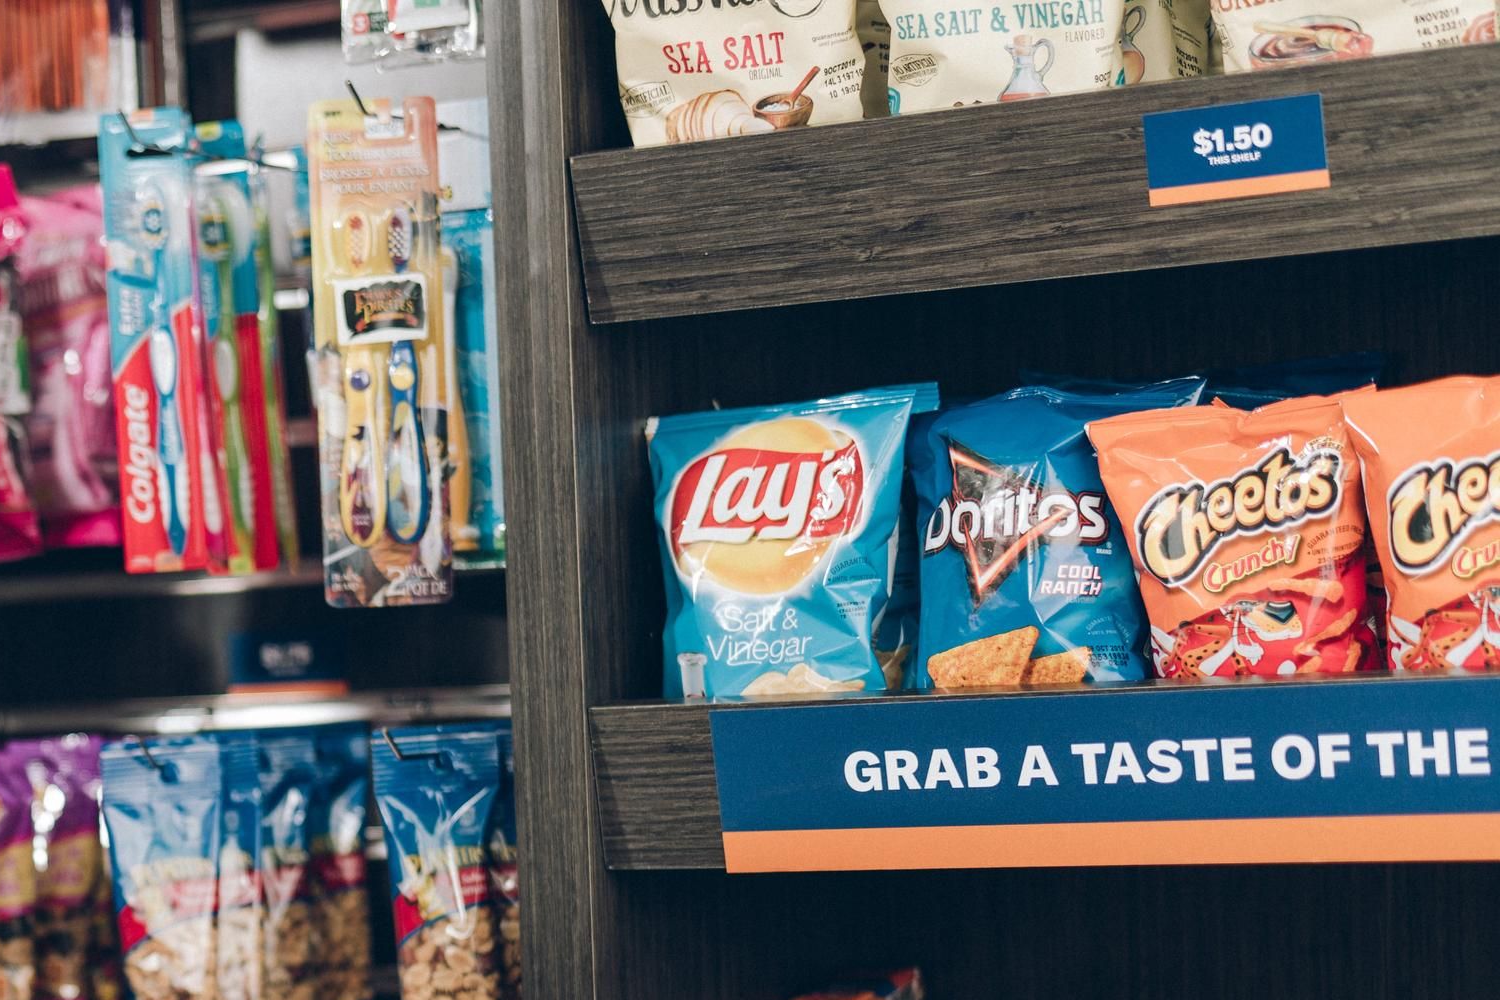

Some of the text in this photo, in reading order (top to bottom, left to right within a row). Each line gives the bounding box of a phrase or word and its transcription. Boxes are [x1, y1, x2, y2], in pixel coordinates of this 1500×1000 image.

[896, 14, 929, 40] SEA
[934, 9, 983, 36] SALT
[990, 6, 1010, 32] &
[1064, 28, 1106, 43] FLAVORED
[662, 31, 785, 75] SEA SALT
[748, 68, 783, 81] ORIGINAL
[1192, 122, 1274, 157] $1.50
[1208, 151, 1262, 166] THIS SHELF
[124, 383, 157, 525] Colgate
[678, 449, 856, 546] Lay's
[924, 486, 1107, 552] Doritos
[1140, 449, 1338, 581] Cheetos
[1057, 564, 1102, 580] COOL
[1204, 535, 1301, 591] Crunchy
[1040, 579, 1103, 596] RANCH
[724, 602, 798, 633] Salt &
[706, 635, 813, 664] Vinegar
[843, 728, 1493, 793] GRAB A TASTE OF THE
